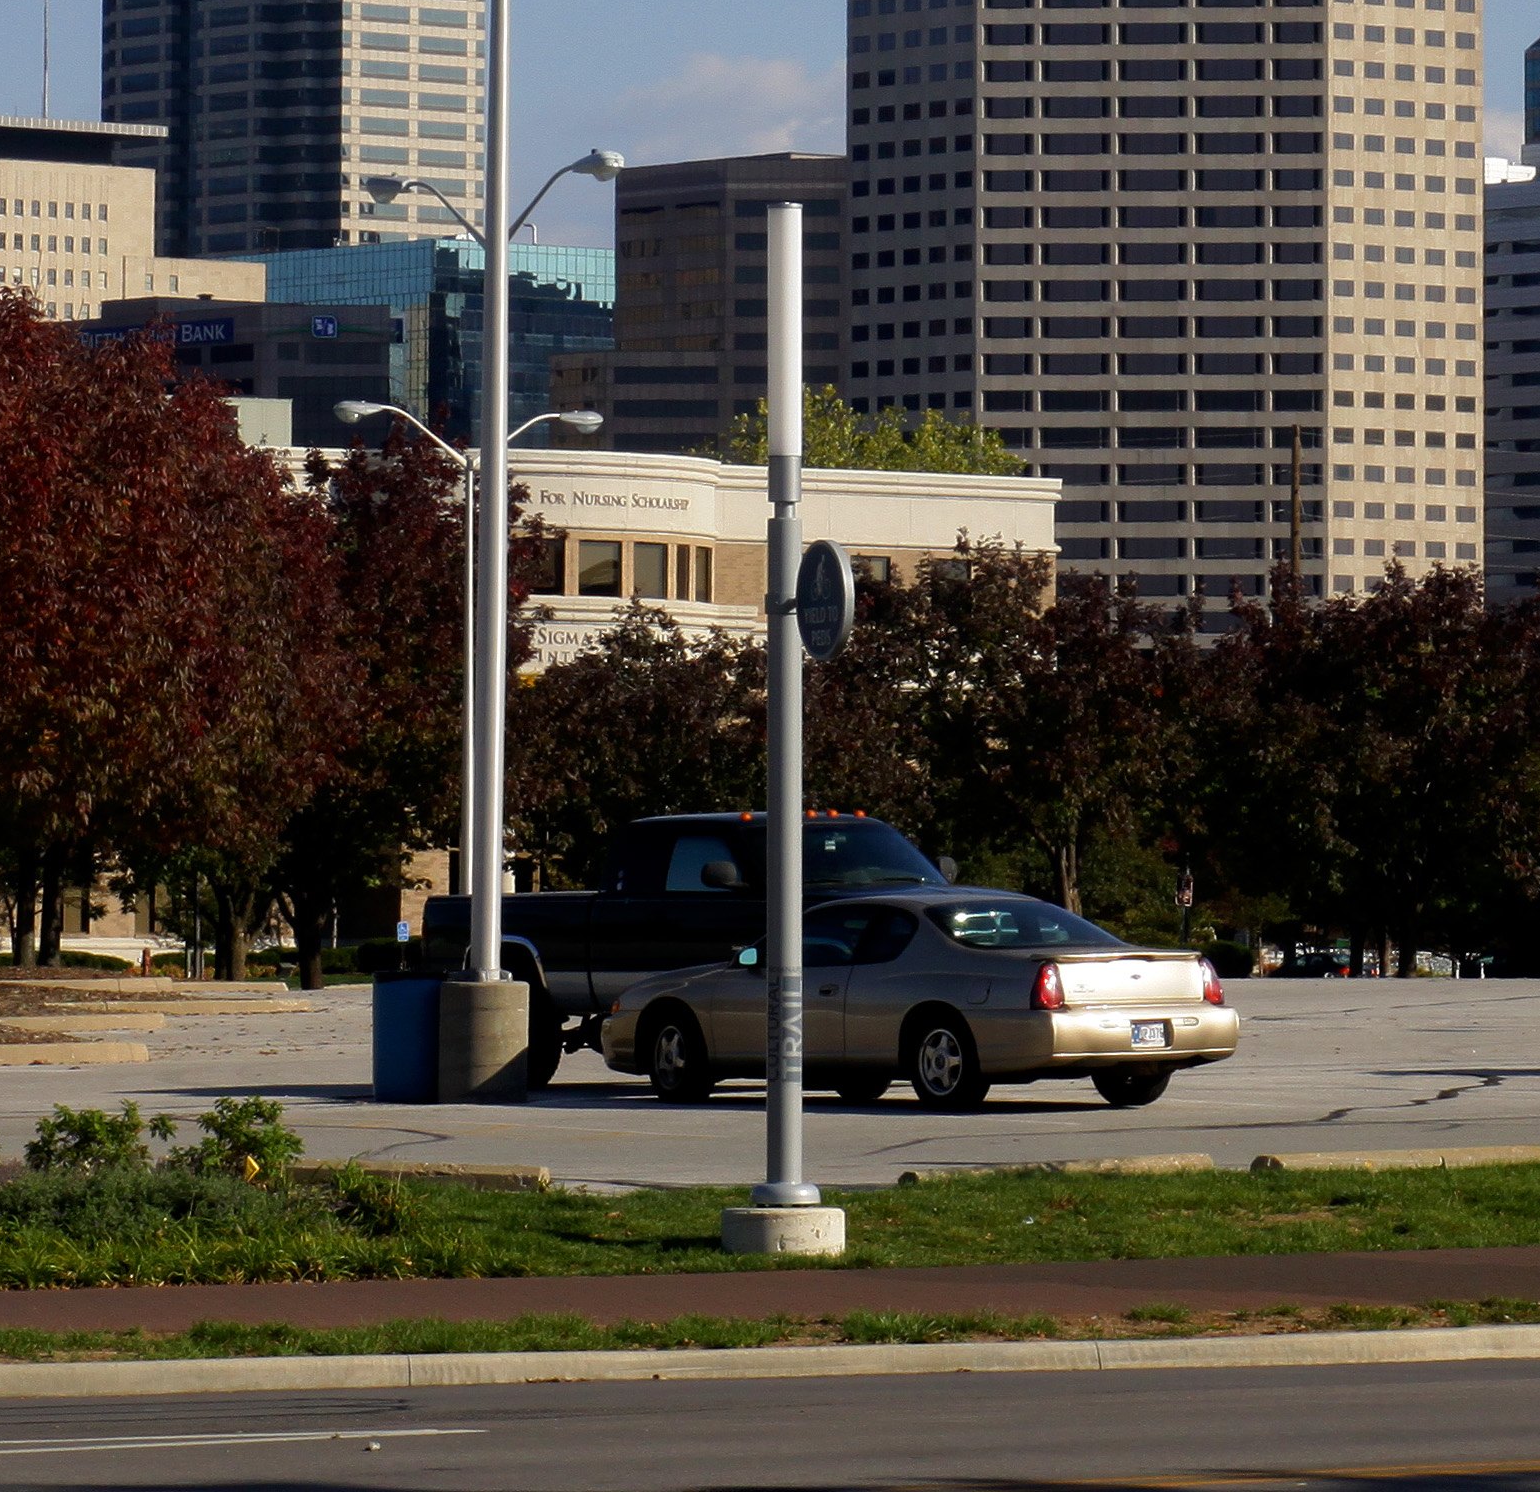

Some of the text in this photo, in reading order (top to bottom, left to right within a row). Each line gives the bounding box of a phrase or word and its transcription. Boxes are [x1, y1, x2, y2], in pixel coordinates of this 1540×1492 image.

[181, 323, 226, 342] BANK
[540, 489, 566, 505] FOR
[538, 627, 593, 646] SIGMA
[781, 976, 802, 1083] TRAIL
